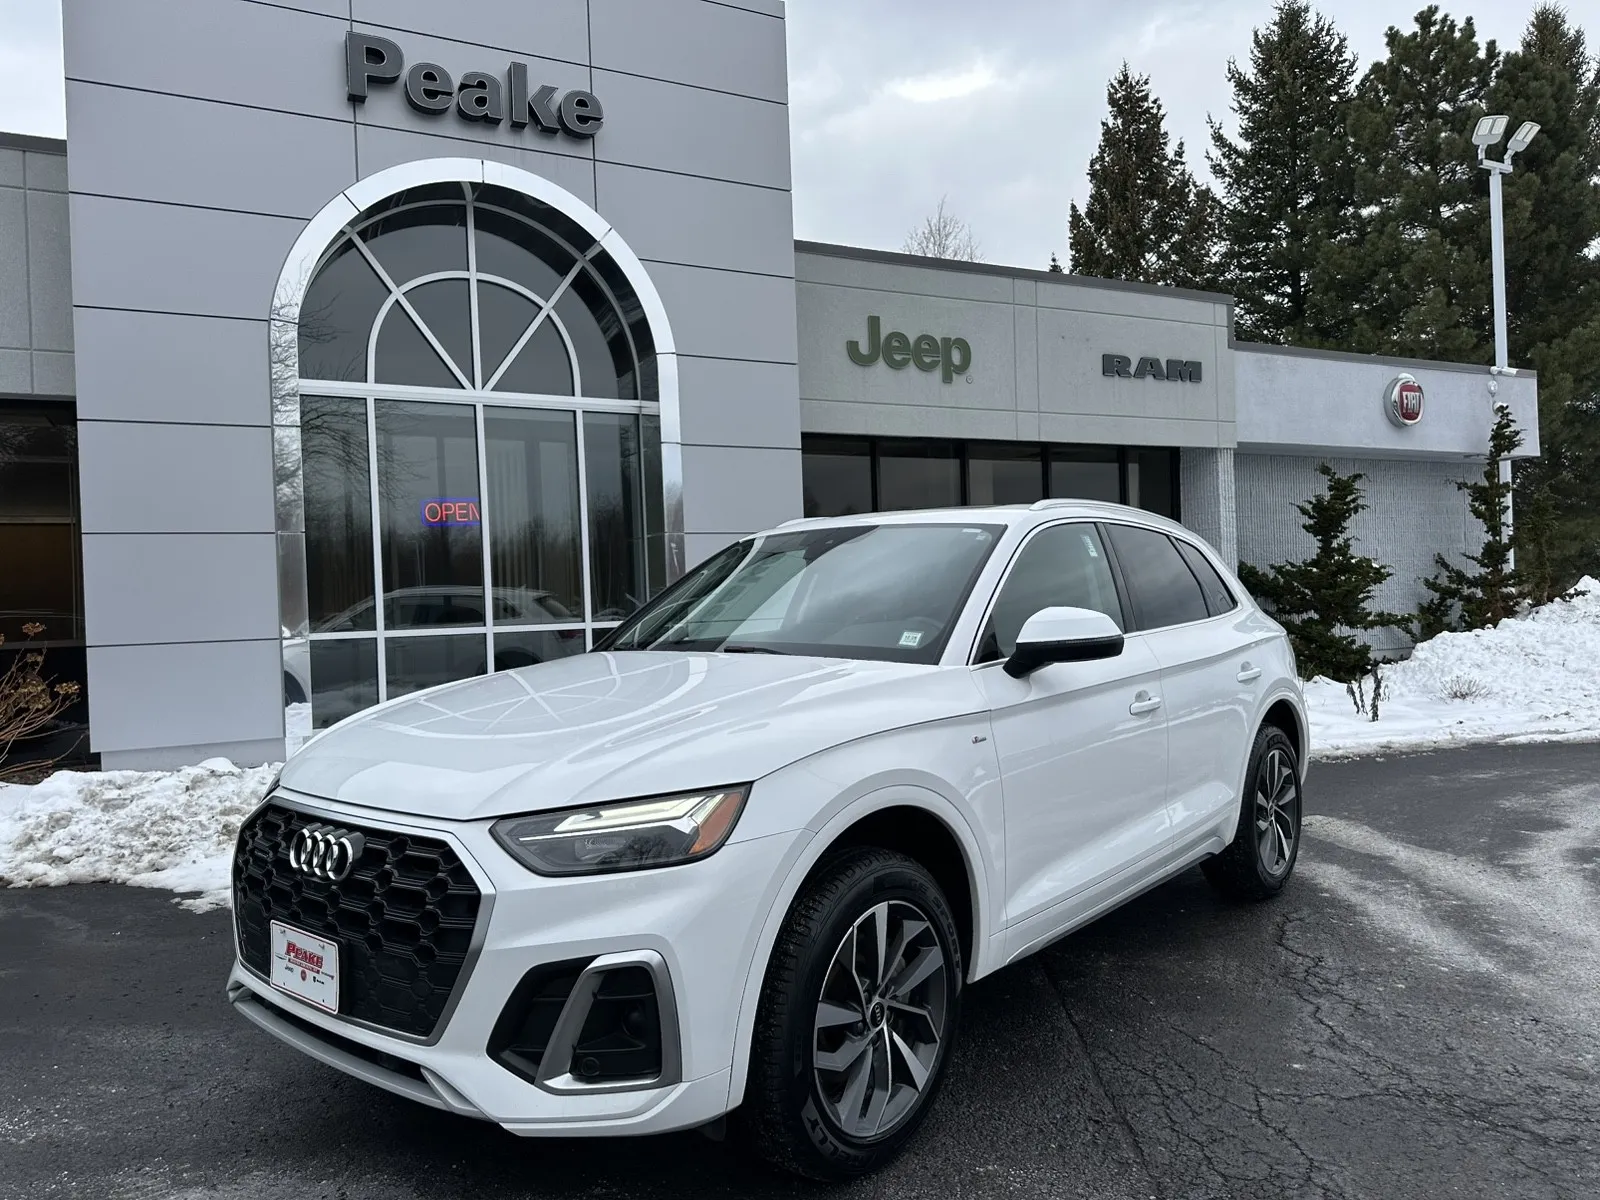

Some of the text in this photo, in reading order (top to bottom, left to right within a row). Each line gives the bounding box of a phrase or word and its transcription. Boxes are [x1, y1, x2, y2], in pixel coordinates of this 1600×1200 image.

[345, 31, 604, 139] Peake
[847, 315, 972, 384] Jeep
[1102, 353, 1203, 383] RAM
[1402, 391, 1421, 413] FIAT
[425, 502, 480, 522] OPEN
[931, 895, 961, 969] SPORT
